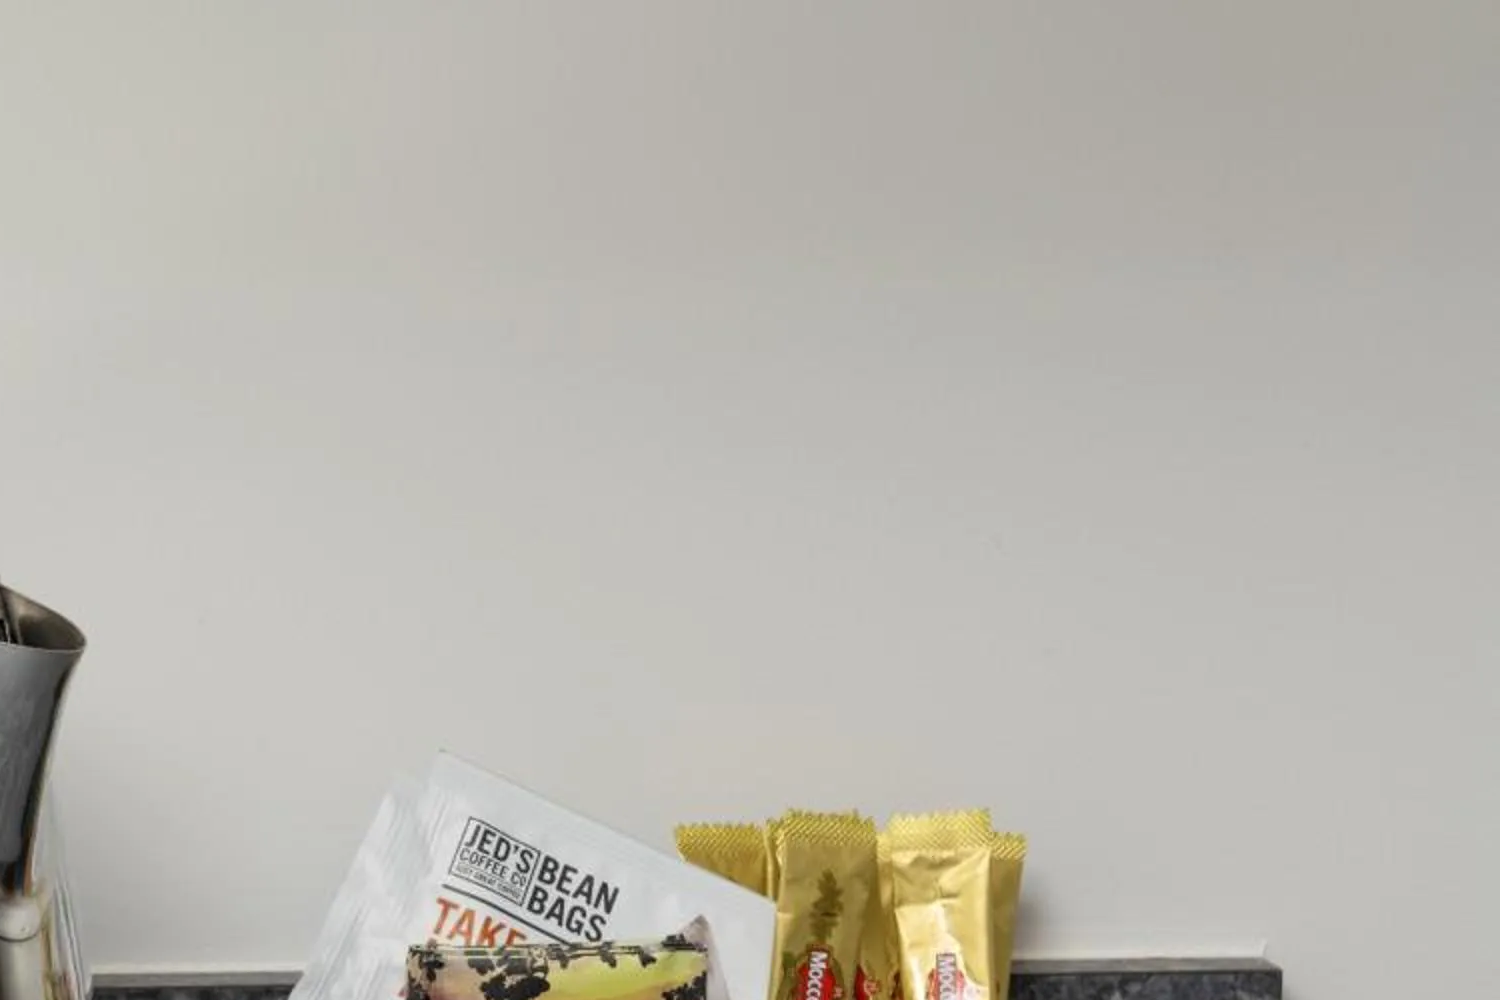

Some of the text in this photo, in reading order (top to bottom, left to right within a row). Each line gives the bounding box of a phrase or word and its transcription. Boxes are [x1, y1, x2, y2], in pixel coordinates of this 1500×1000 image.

[458, 847, 510, 880] COFFEE
[463, 824, 534, 875] JED'S
[537, 855, 620, 915] BEAN
[526, 885, 607, 943] BAGS
